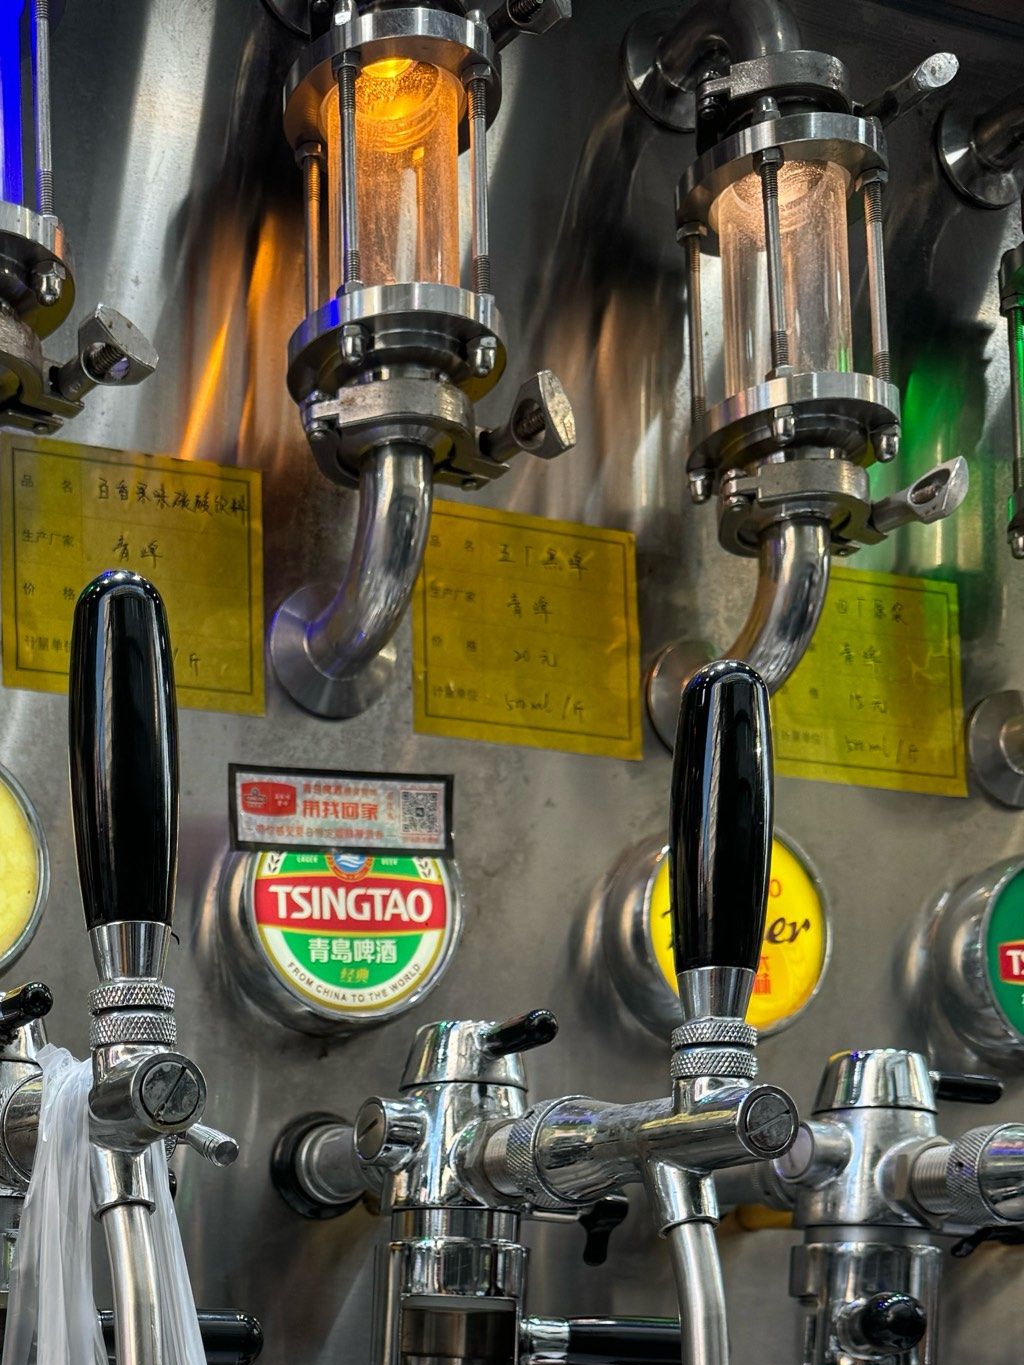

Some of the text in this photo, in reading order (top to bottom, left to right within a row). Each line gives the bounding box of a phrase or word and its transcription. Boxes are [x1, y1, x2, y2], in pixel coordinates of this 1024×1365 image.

[22, 529, 75, 548] 生产厂家
[301, 800, 379, 821] 带我回家
[268, 884, 433, 923] TSINGTAO
[308, 938, 398, 965] 青岛啤酒
[287, 961, 422, 1003] FROM CHINA TO THE WORLD
[340, 967, 370, 984] 经典
